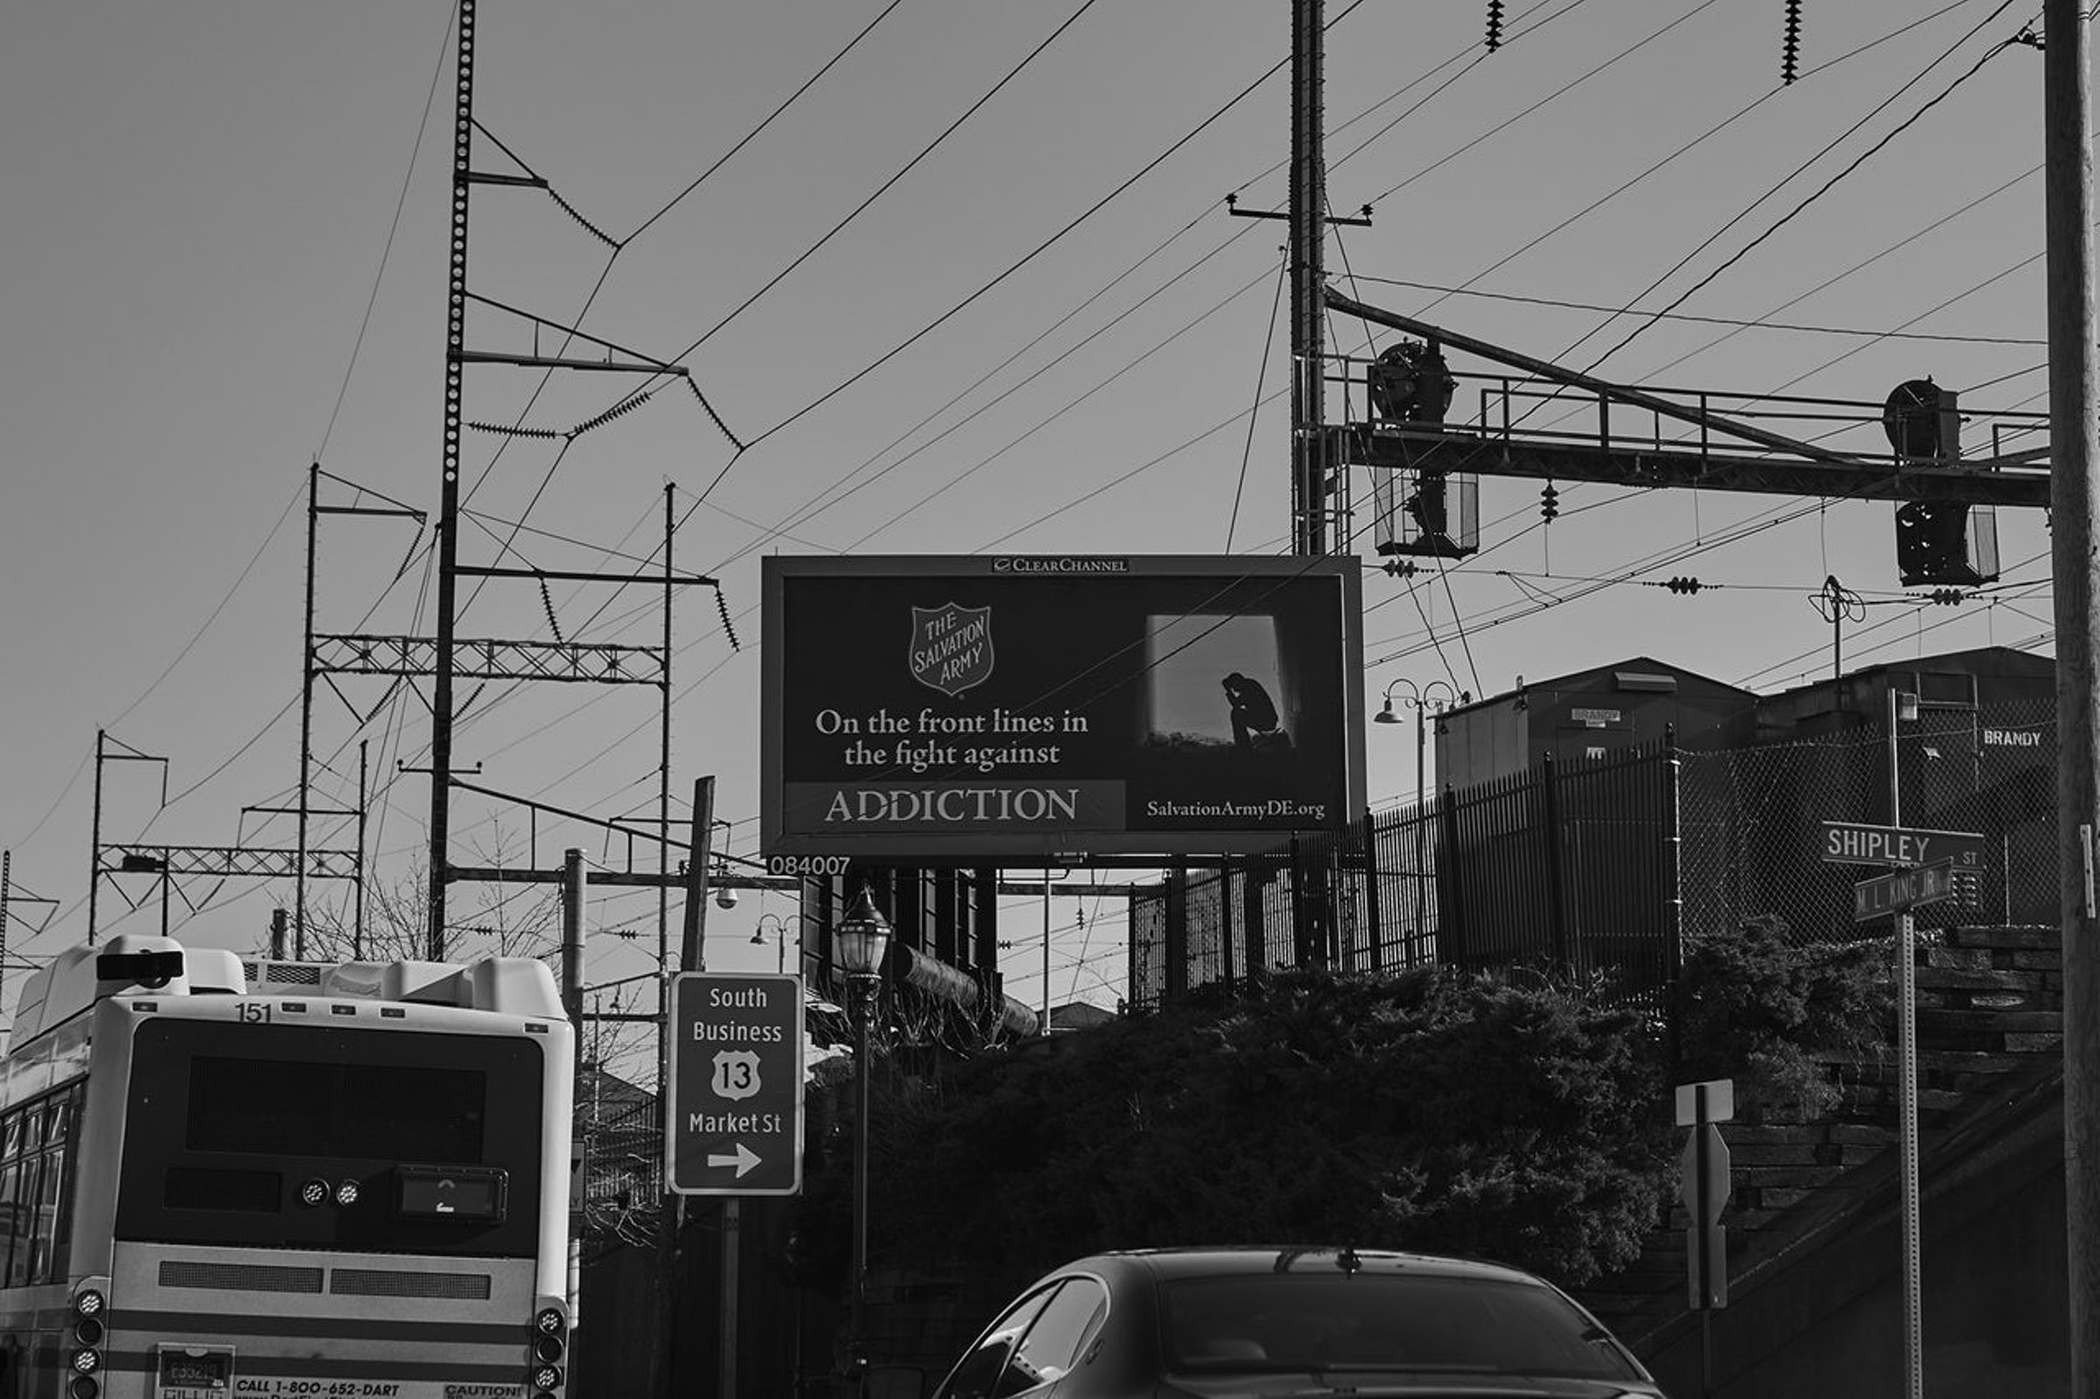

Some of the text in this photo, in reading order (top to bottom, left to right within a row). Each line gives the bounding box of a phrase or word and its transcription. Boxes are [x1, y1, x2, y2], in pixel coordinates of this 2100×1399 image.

[925, 610, 957, 641] THE
[914, 615, 986, 673] SALVATION
[939, 642, 983, 685] ARMY
[815, 707, 1089, 734] On the front lines in
[1984, 730, 2040, 746] BRANDY
[844, 739, 1061, 773] the fight against
[824, 788, 1080, 822] ADDICTION
[1147, 800, 1326, 821] SalvationArmyDE.org
[1827, 828, 1978, 865] SHIPLEY ST
[770, 856, 851, 875] 084007
[1874, 885, 1881, 909] L
[1889, 876, 1917, 906] KING
[1921, 870, 1935, 897] JR
[709, 987, 768, 1008] South
[235, 1003, 271, 1023] 151
[693, 1020, 783, 1042] Business
[721, 1061, 751, 1090] 13
[689, 1112, 781, 1133] Market St
[236, 1379, 400, 1397] CALL 1-800-652-DART
[445, 1385, 521, 1397] CAUTION!
